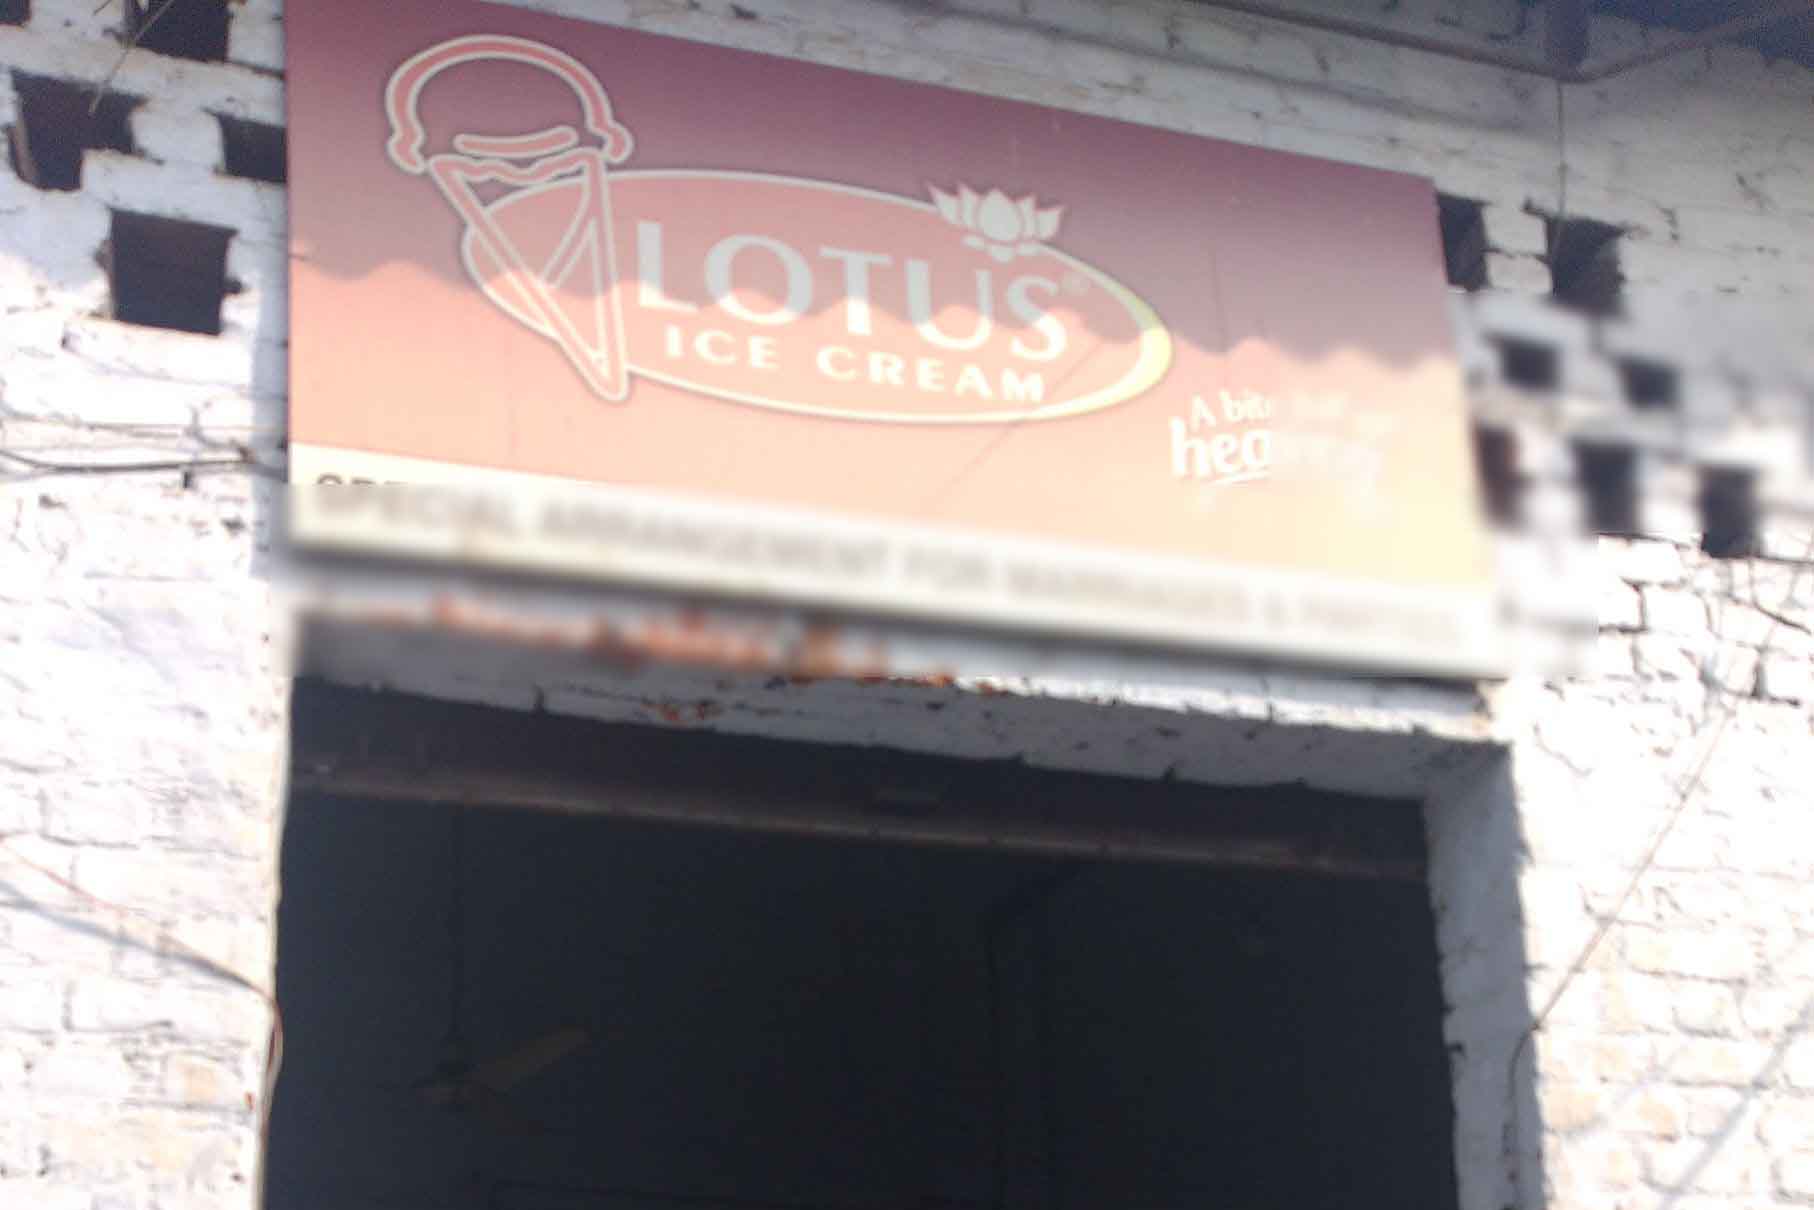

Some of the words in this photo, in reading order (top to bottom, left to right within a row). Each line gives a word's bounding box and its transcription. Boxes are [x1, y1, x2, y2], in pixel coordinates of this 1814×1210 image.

[637, 221, 1068, 361] LOTUS
[665, 325, 780, 369] ICE
[816, 347, 1046, 402] CREAM
